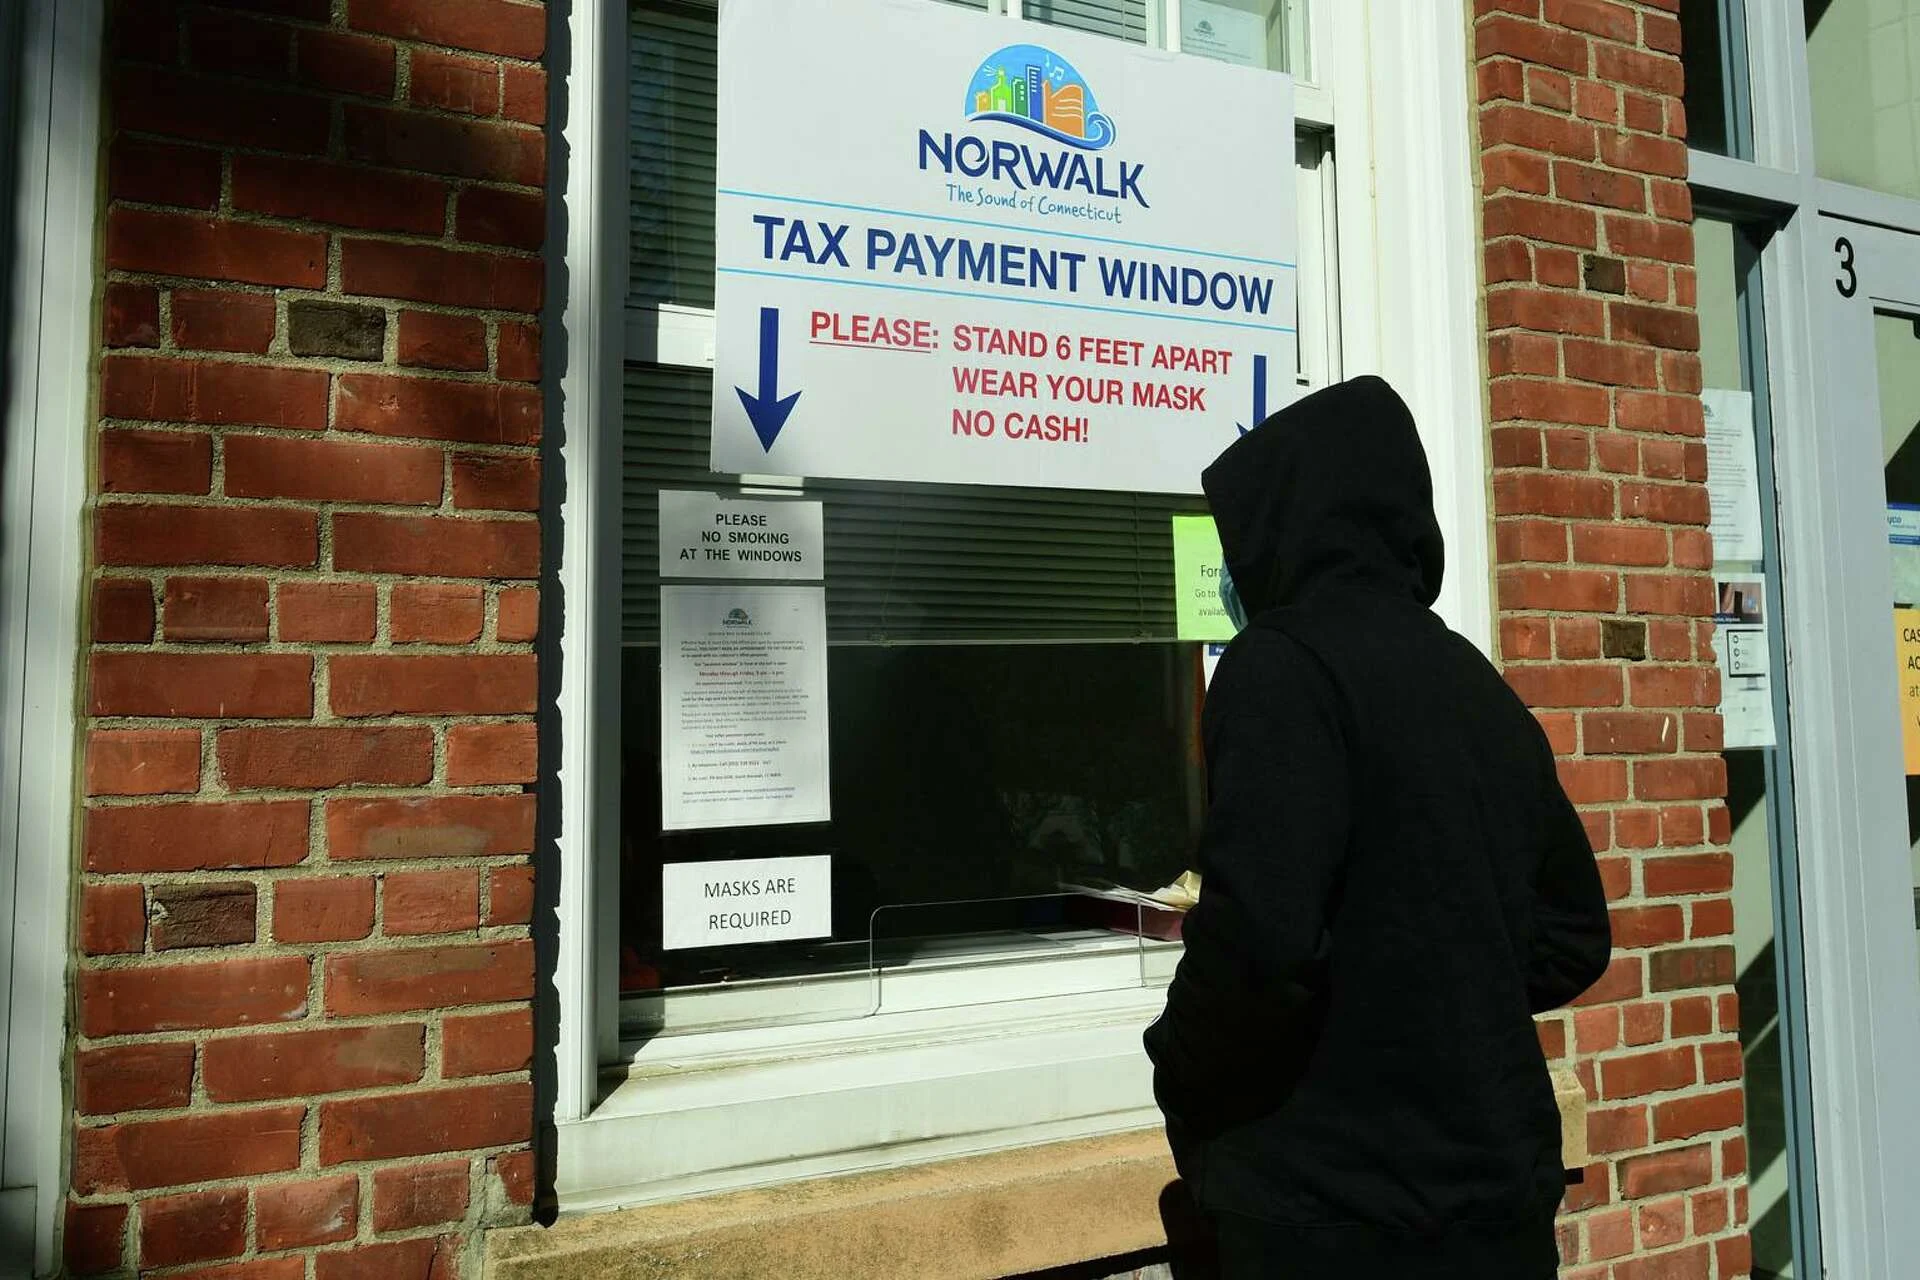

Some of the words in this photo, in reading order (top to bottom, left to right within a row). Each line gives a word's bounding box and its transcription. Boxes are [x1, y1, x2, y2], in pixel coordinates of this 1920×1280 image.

[919, 128, 1150, 208] NORWALK
[946, 183, 974, 204] The
[976, 187, 1017, 209] Sound
[1020, 196, 1034, 212] of
[1037, 196, 1123, 224] Connecticut
[753, 215, 850, 267] TAX
[866, 228, 1087, 293] PAYMENT
[1098, 258, 1275, 315] WINDOW
[1834, 237, 1857, 298] 3
[810, 311, 940, 350] PLEASE:
[953, 325, 1048, 358] STAND
[1056, 335, 1070, 361] 6
[1079, 339, 1144, 367] FEET
[1151, 345, 1233, 375] APART
[952, 367, 1038, 400] WEAR
[1045, 374, 1124, 406] YOUR
[1132, 382, 1206, 412] MASK
[952, 409, 995, 437] NO
[1004, 413, 1089, 443] CASH!
[715, 514, 767, 527] PLEASE
[679, 548, 697, 561] AT
[704, 549, 730, 561] THE
[737, 550, 802, 562] WINDOWS
[701, 531, 721, 543] NO
[728, 532, 790, 545] SMOKING
[1194, 589, 1207, 599] Go
[1207, 590, 1217, 599] to
[704, 879, 760, 898] MASKS
[765, 878, 796, 895] ARE
[709, 910, 792, 930] REQUIRED
